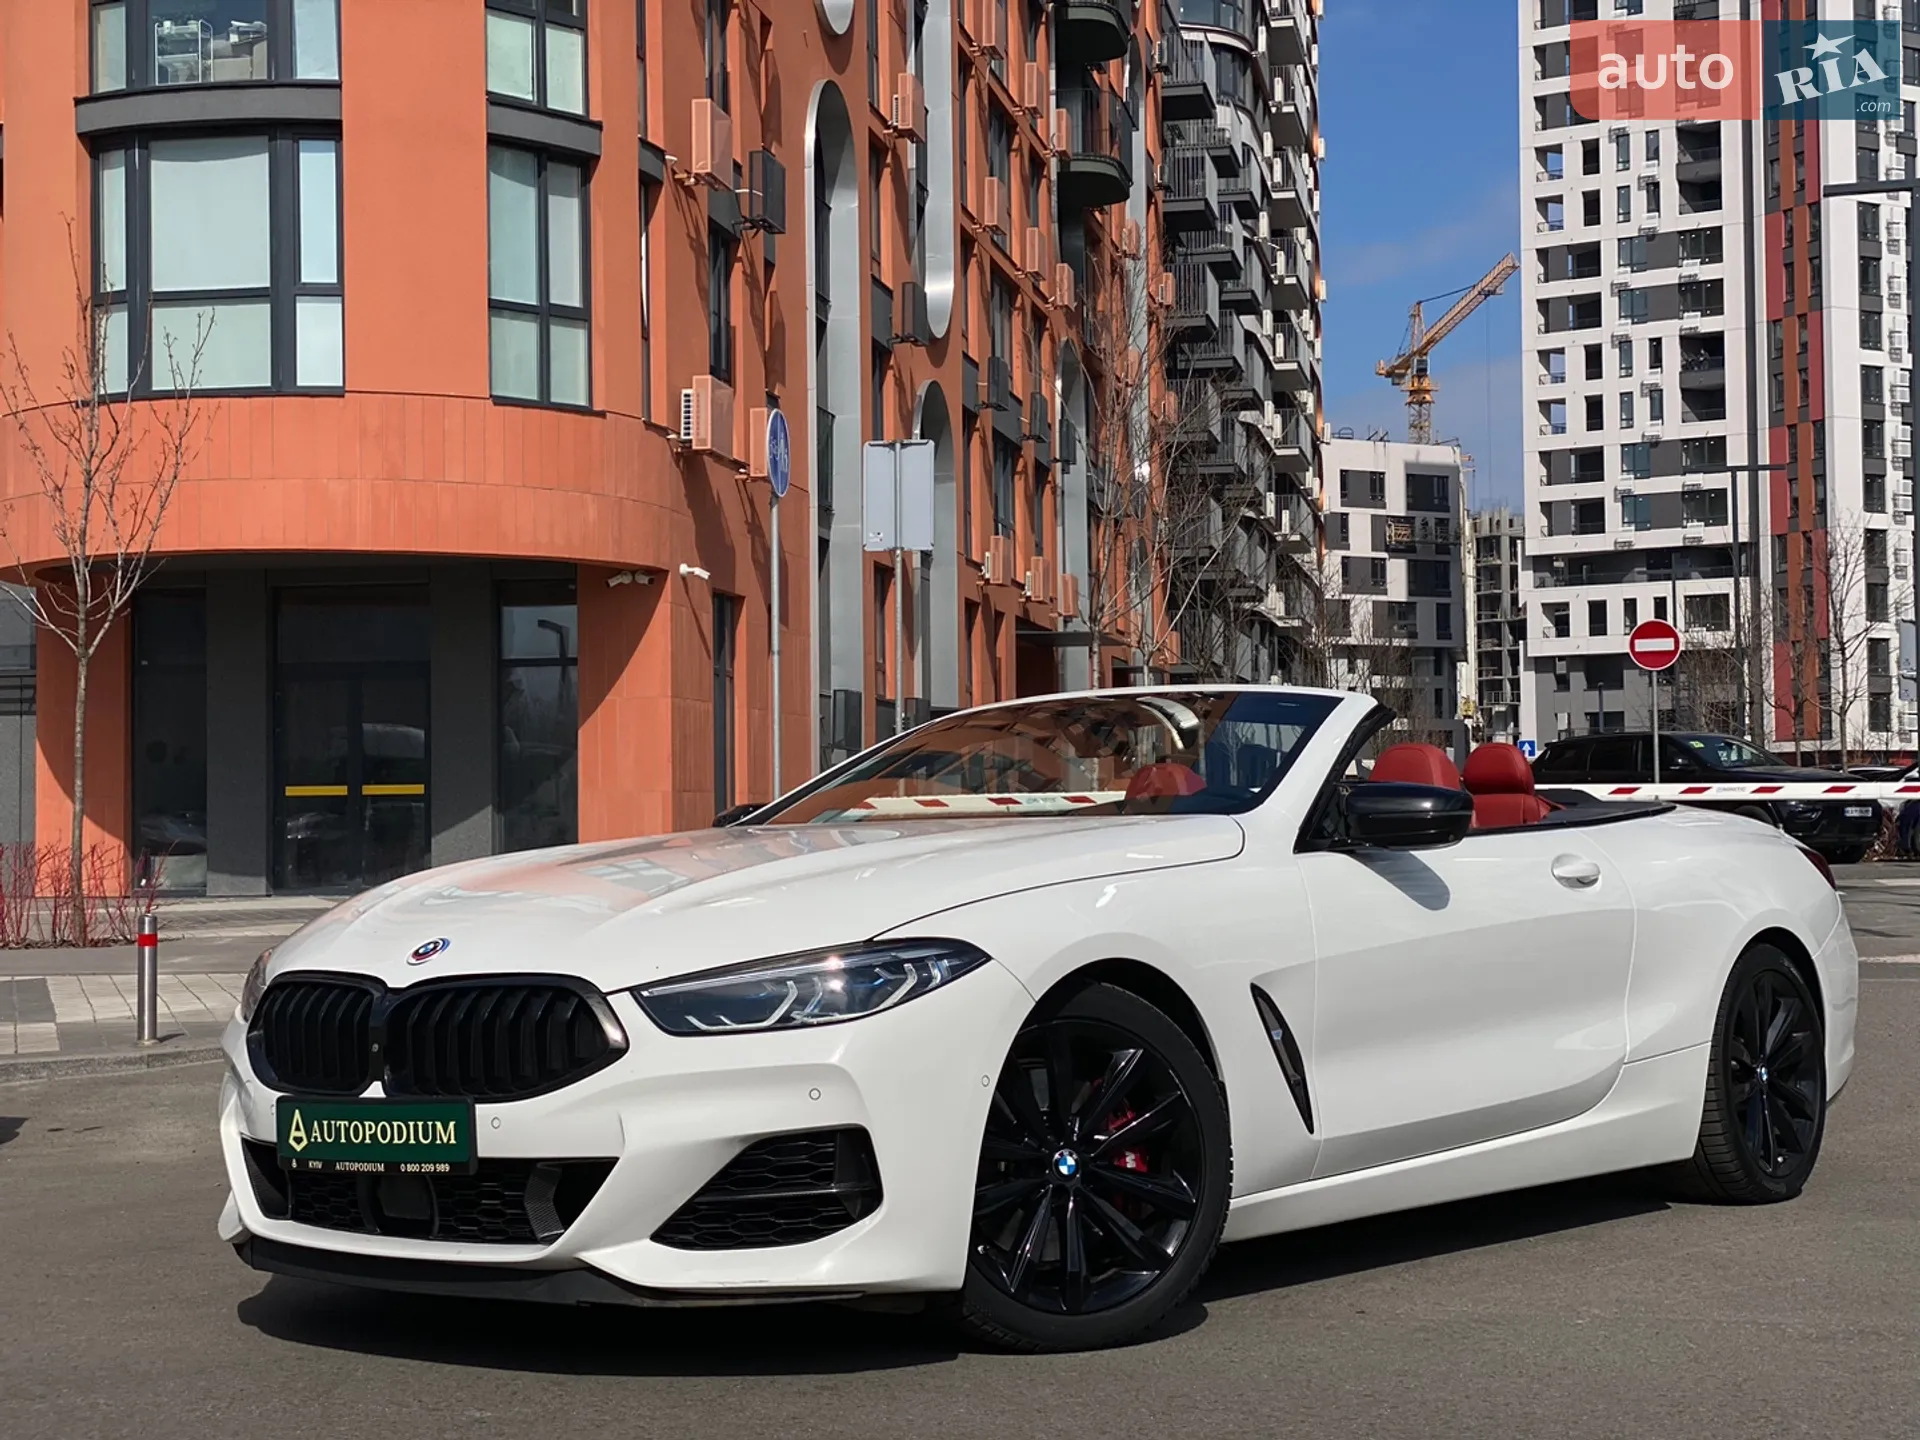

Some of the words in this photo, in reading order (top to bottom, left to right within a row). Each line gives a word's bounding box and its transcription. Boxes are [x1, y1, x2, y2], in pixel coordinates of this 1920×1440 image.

[310, 1120, 457, 1145] AUTOPODIUM
[335, 1161, 385, 1172] AUTOPODIUM
[406, 1162, 420, 1172] 800
[421, 1162, 435, 1172] 209
